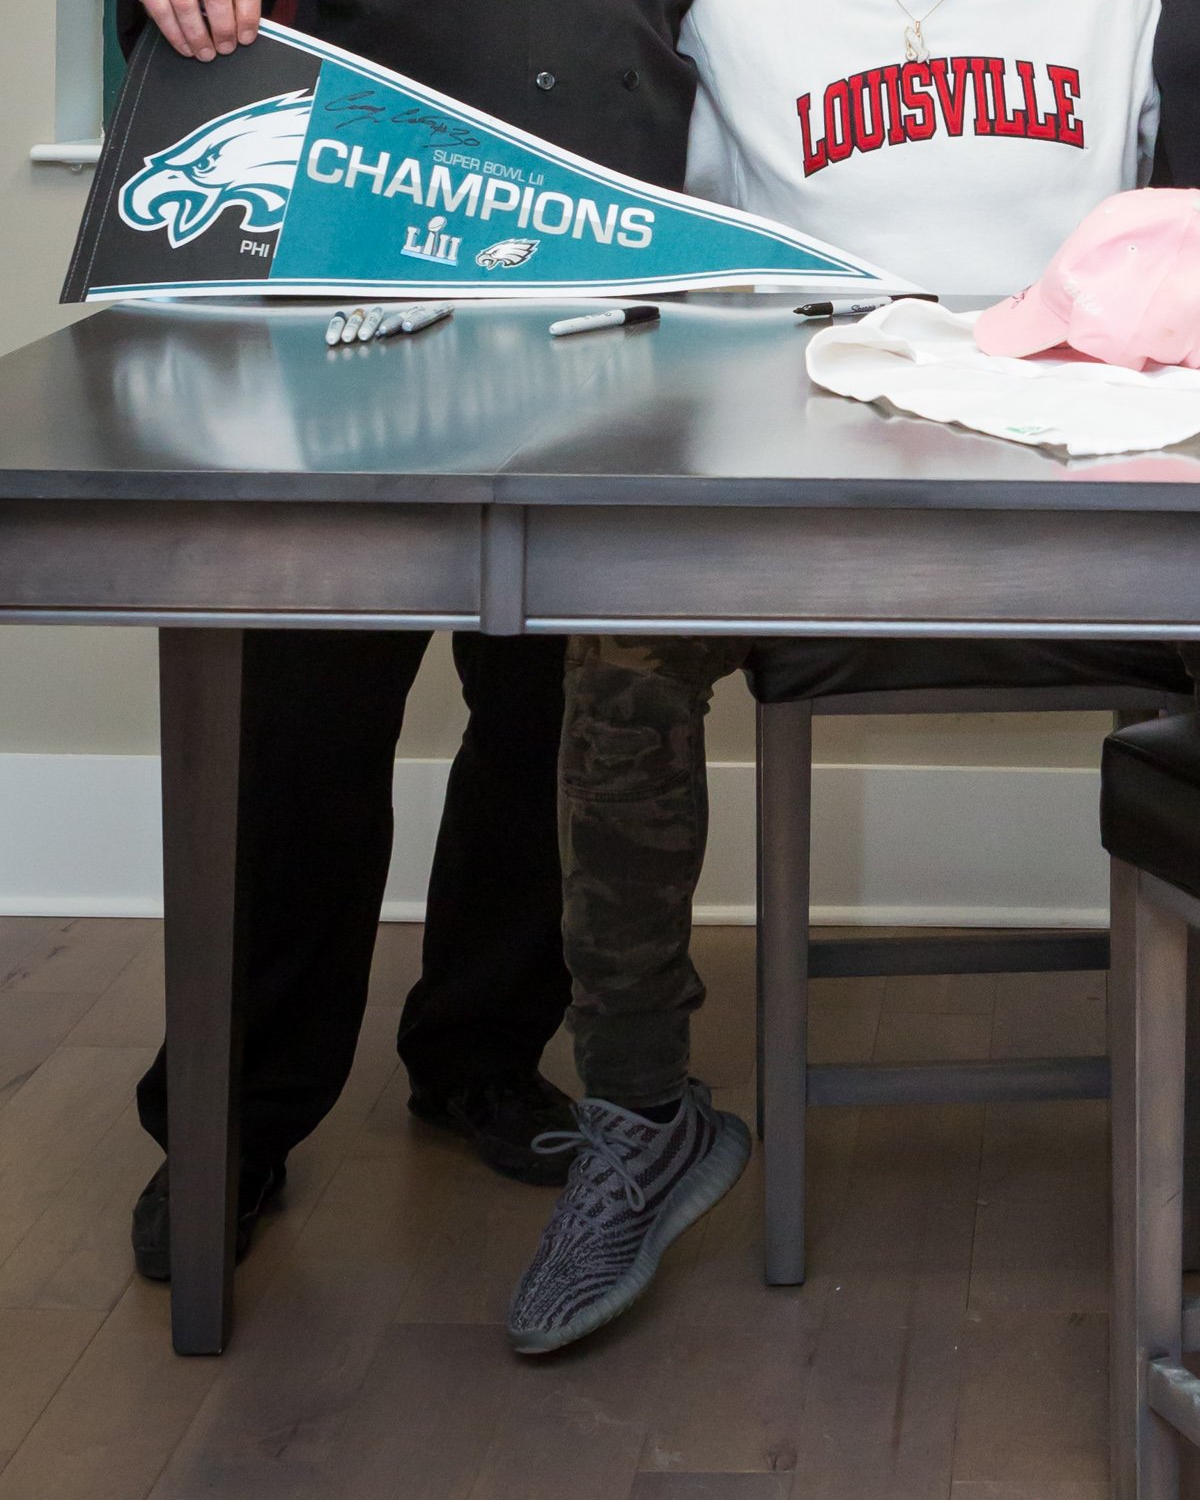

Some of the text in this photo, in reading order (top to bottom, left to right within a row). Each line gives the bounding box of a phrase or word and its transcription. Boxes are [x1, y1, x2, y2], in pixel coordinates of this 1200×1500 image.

[796, 56, 1085, 178] LOUISVILLE
[306, 138, 656, 249] CHAMPIONS
[433, 149, 544, 187] SUPER BOWL LII
[240, 240, 270, 258] PHI
